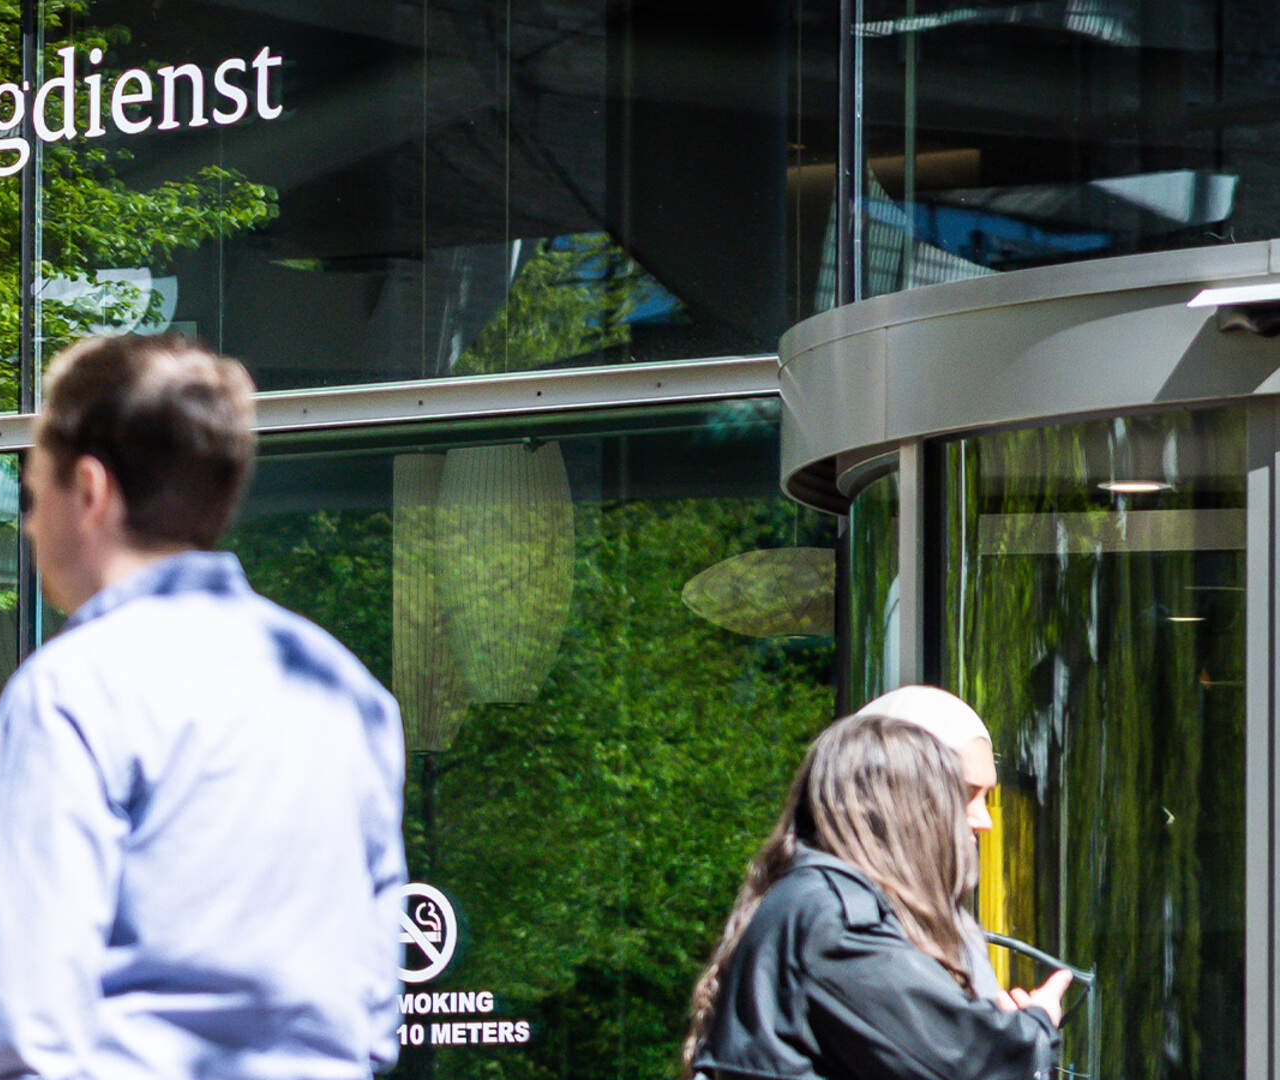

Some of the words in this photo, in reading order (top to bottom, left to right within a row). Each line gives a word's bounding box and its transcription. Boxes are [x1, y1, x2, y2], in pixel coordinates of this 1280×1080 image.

[397, 991, 494, 1015] MOKING
[396, 1022, 425, 1046] 10
[431, 1020, 531, 1045] METERS
